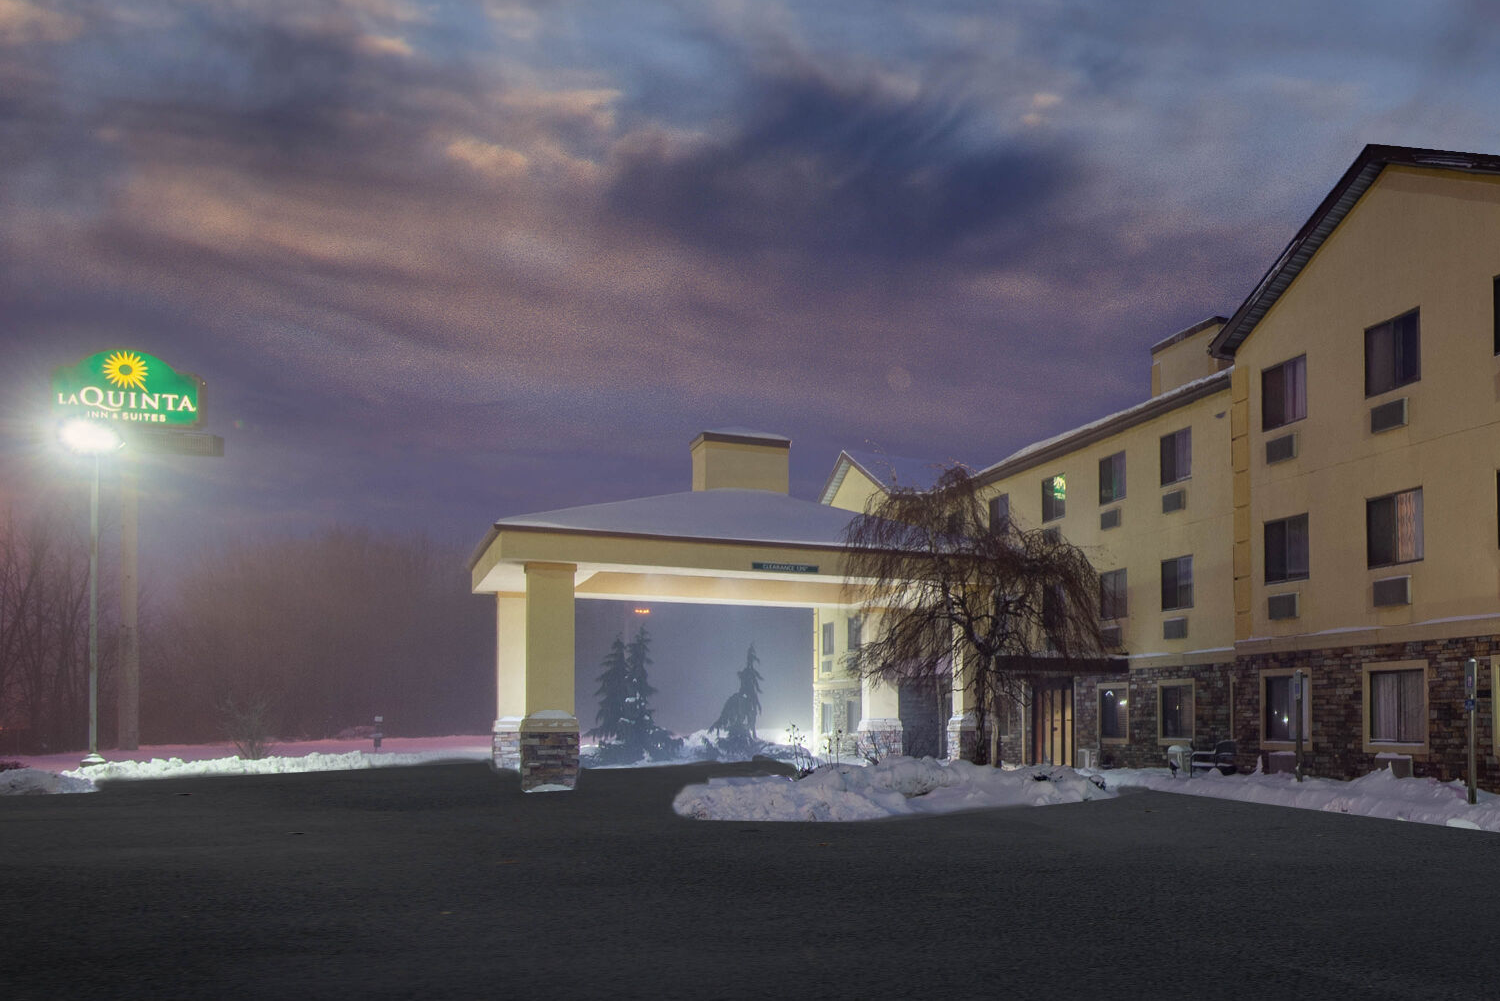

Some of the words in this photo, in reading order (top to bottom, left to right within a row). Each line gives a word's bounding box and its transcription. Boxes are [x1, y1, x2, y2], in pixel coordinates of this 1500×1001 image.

[58, 393, 78, 405] LA
[79, 386, 196, 412] QUINTA
[87, 411, 108, 419] INN
[122, 412, 166, 422] SUITES
